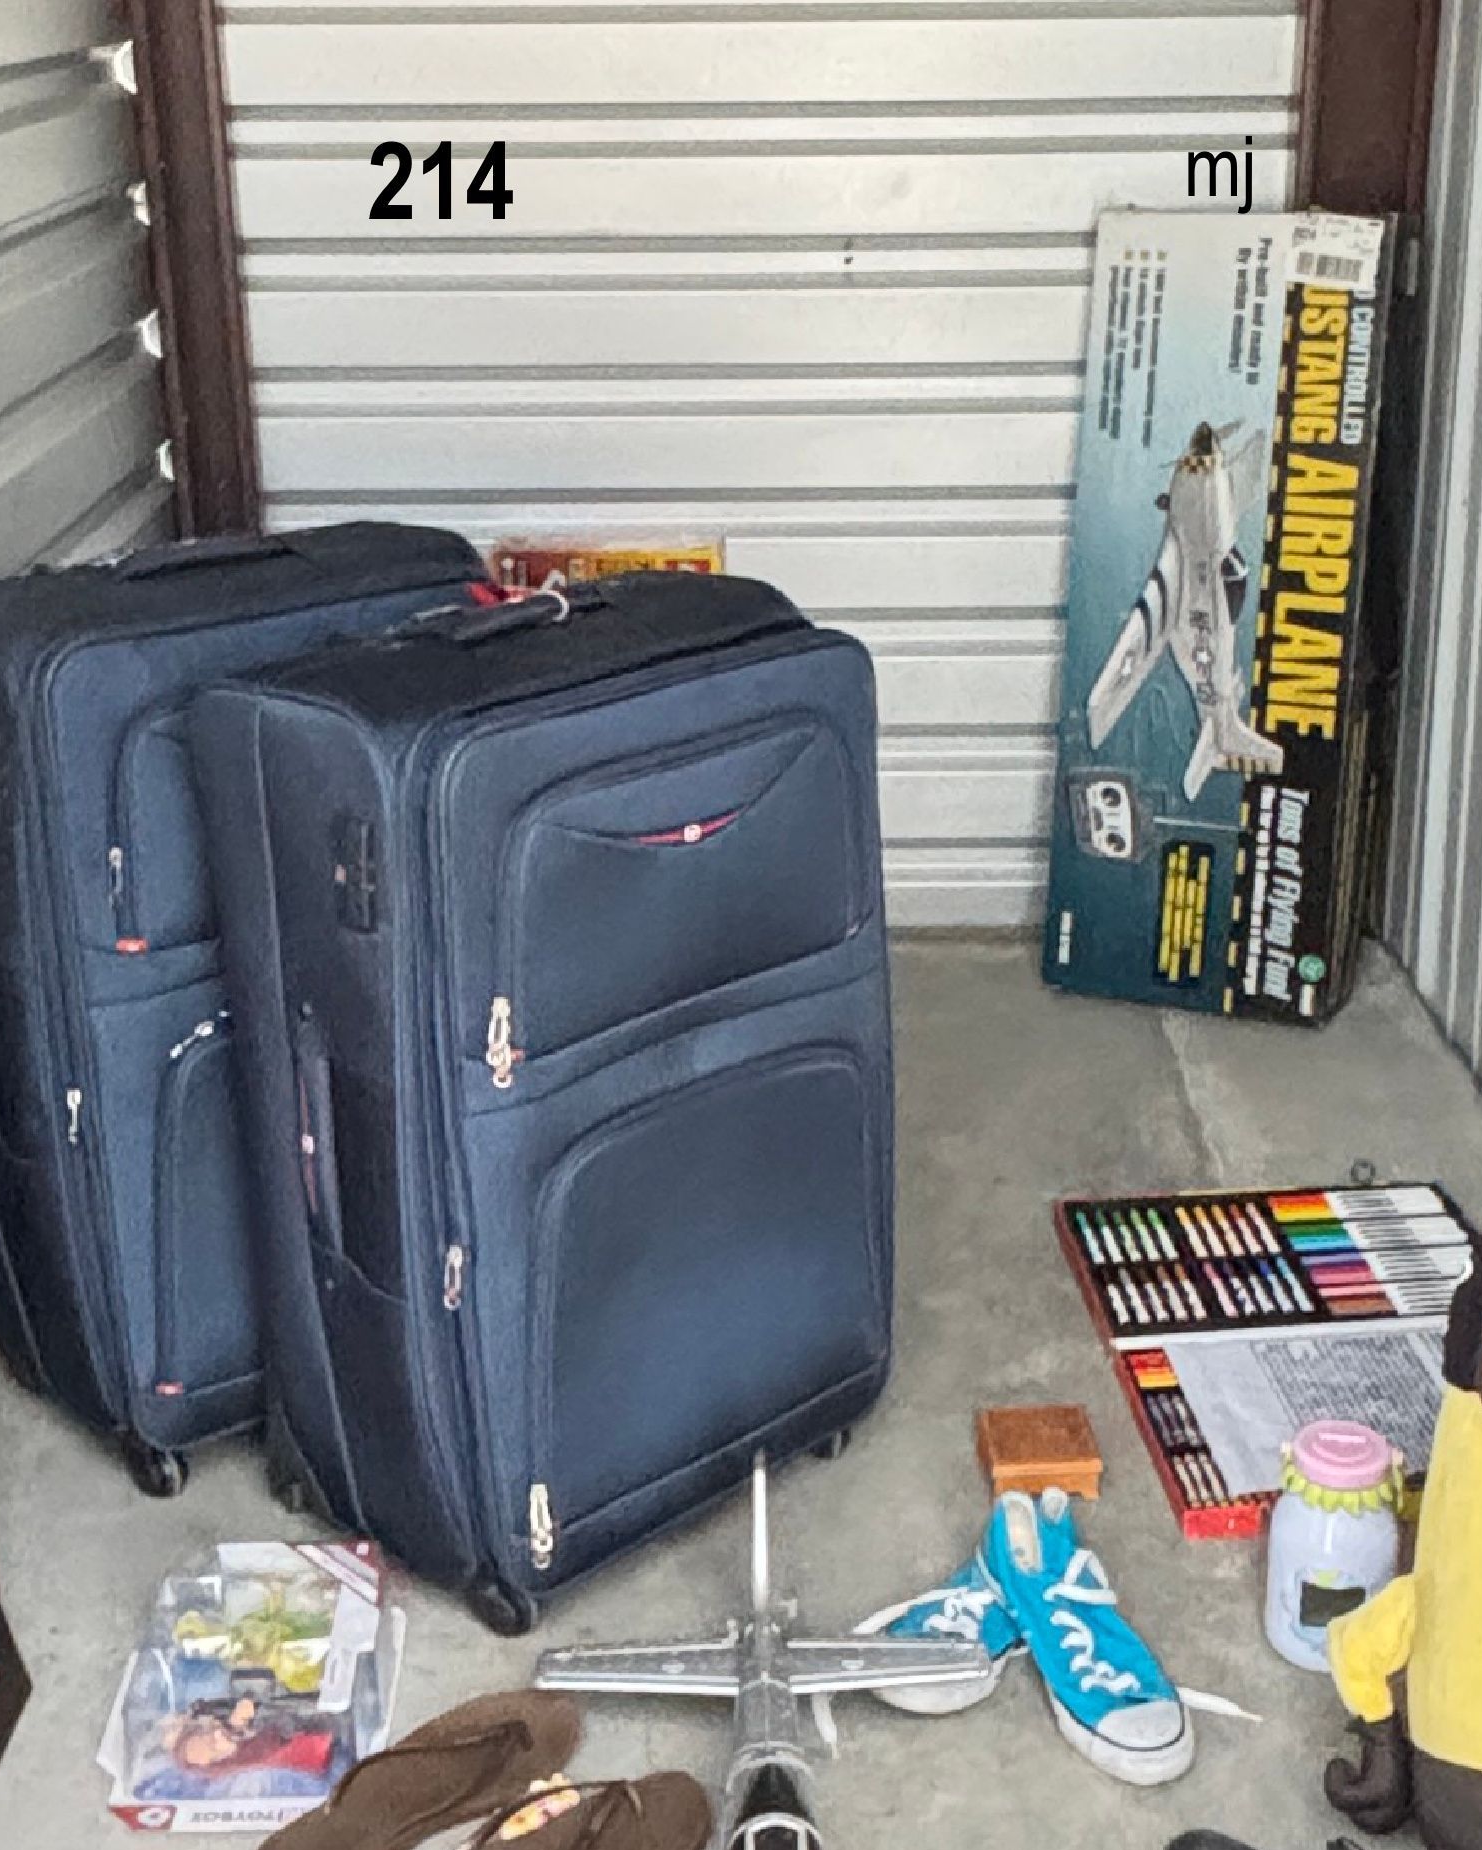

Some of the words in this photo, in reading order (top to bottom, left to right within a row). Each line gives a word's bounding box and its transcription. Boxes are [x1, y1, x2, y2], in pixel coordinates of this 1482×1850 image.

[1290, 285, 1350, 445] USTANG
[1266, 452, 1360, 739] AIRPLANE
[1265, 876, 1303, 953] Flying
[1273, 846, 1303, 878] of
